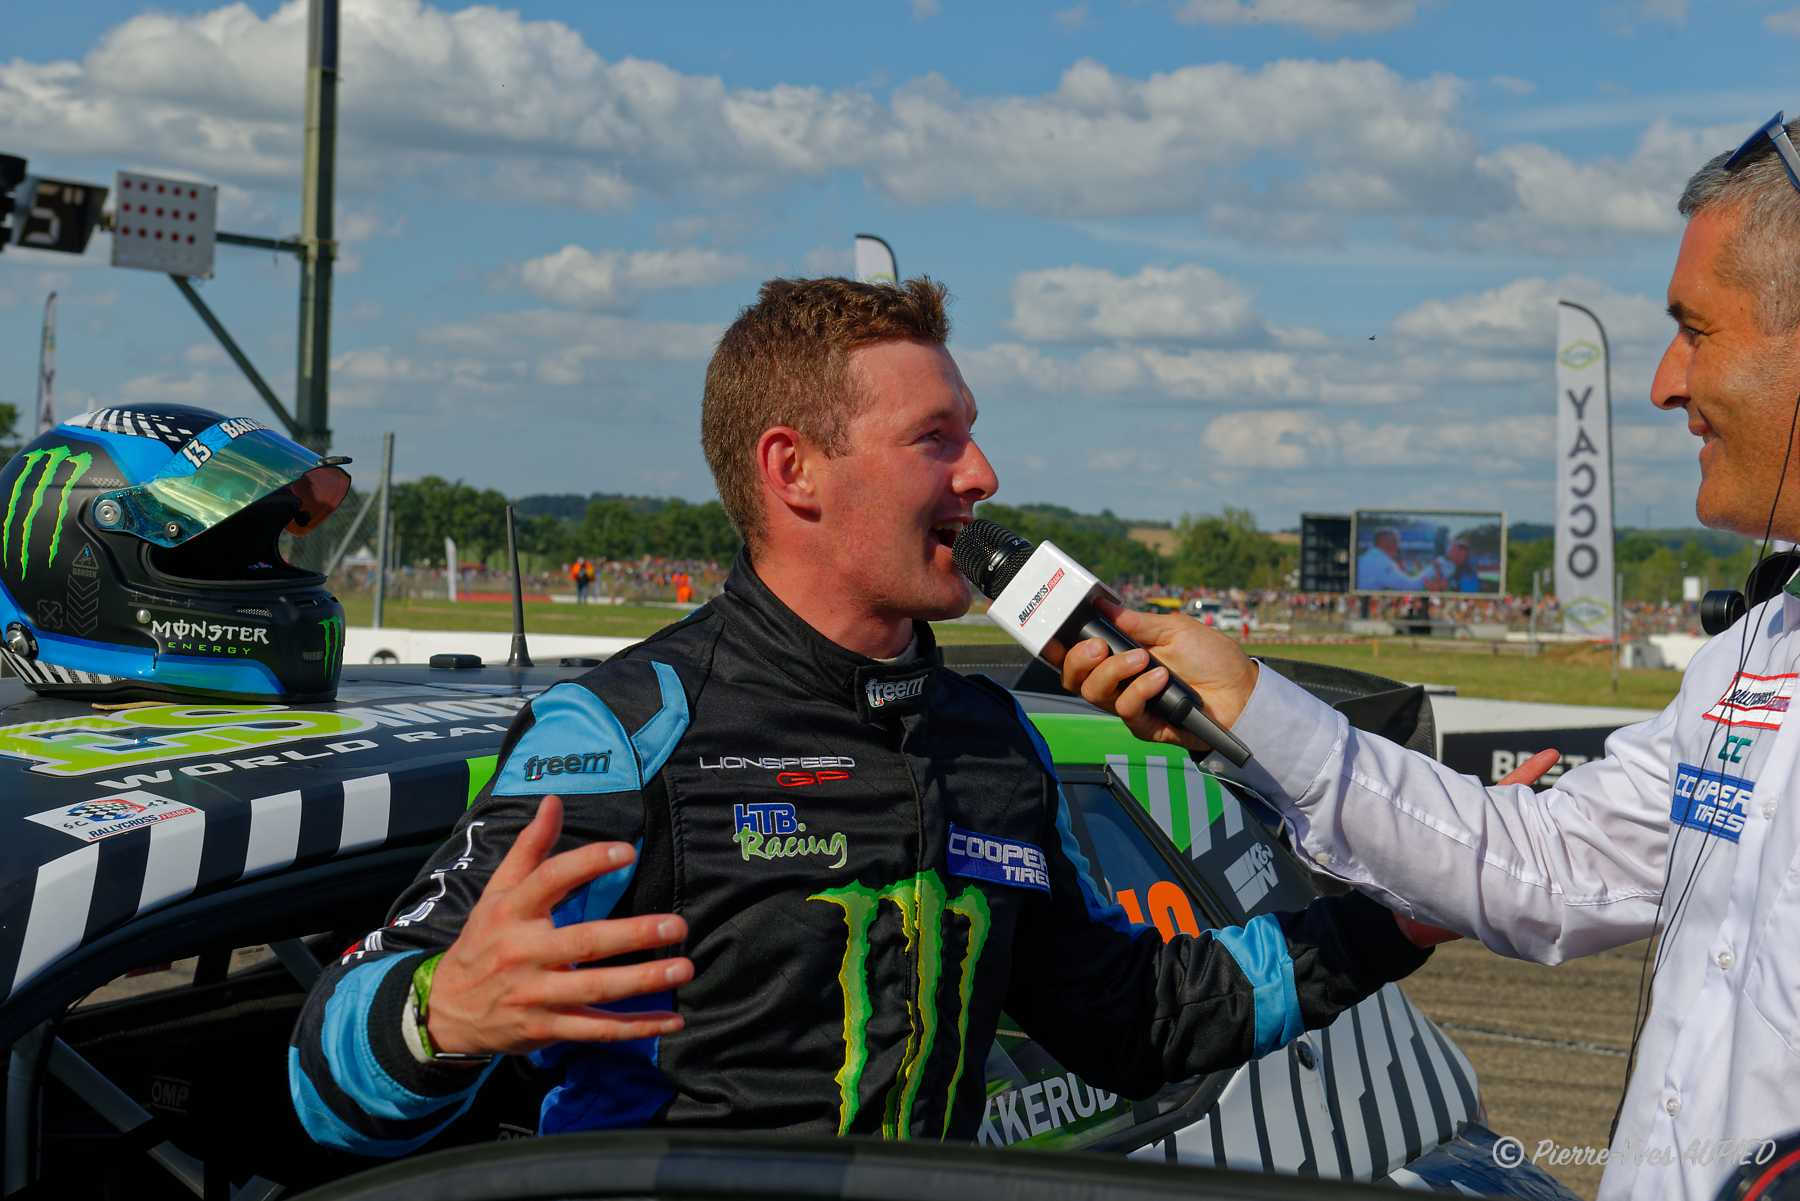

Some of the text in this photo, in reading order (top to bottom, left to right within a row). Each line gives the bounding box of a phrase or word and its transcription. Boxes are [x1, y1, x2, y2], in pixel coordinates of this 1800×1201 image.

[182, 439, 212, 470] 13
[152, 619, 270, 645] MONSTER
[167, 641, 252, 655] ENERGY
[865, 674, 928, 707] freem
[95, 739, 379, 789] WORLD
[524, 750, 612, 781] freem
[699, 756, 855, 769] LIONSPEED
[775, 770, 849, 787] GP
[90, 814, 158, 838] RALLYCROSS
[734, 803, 798, 835] HTB
[733, 823, 848, 869] Racing
